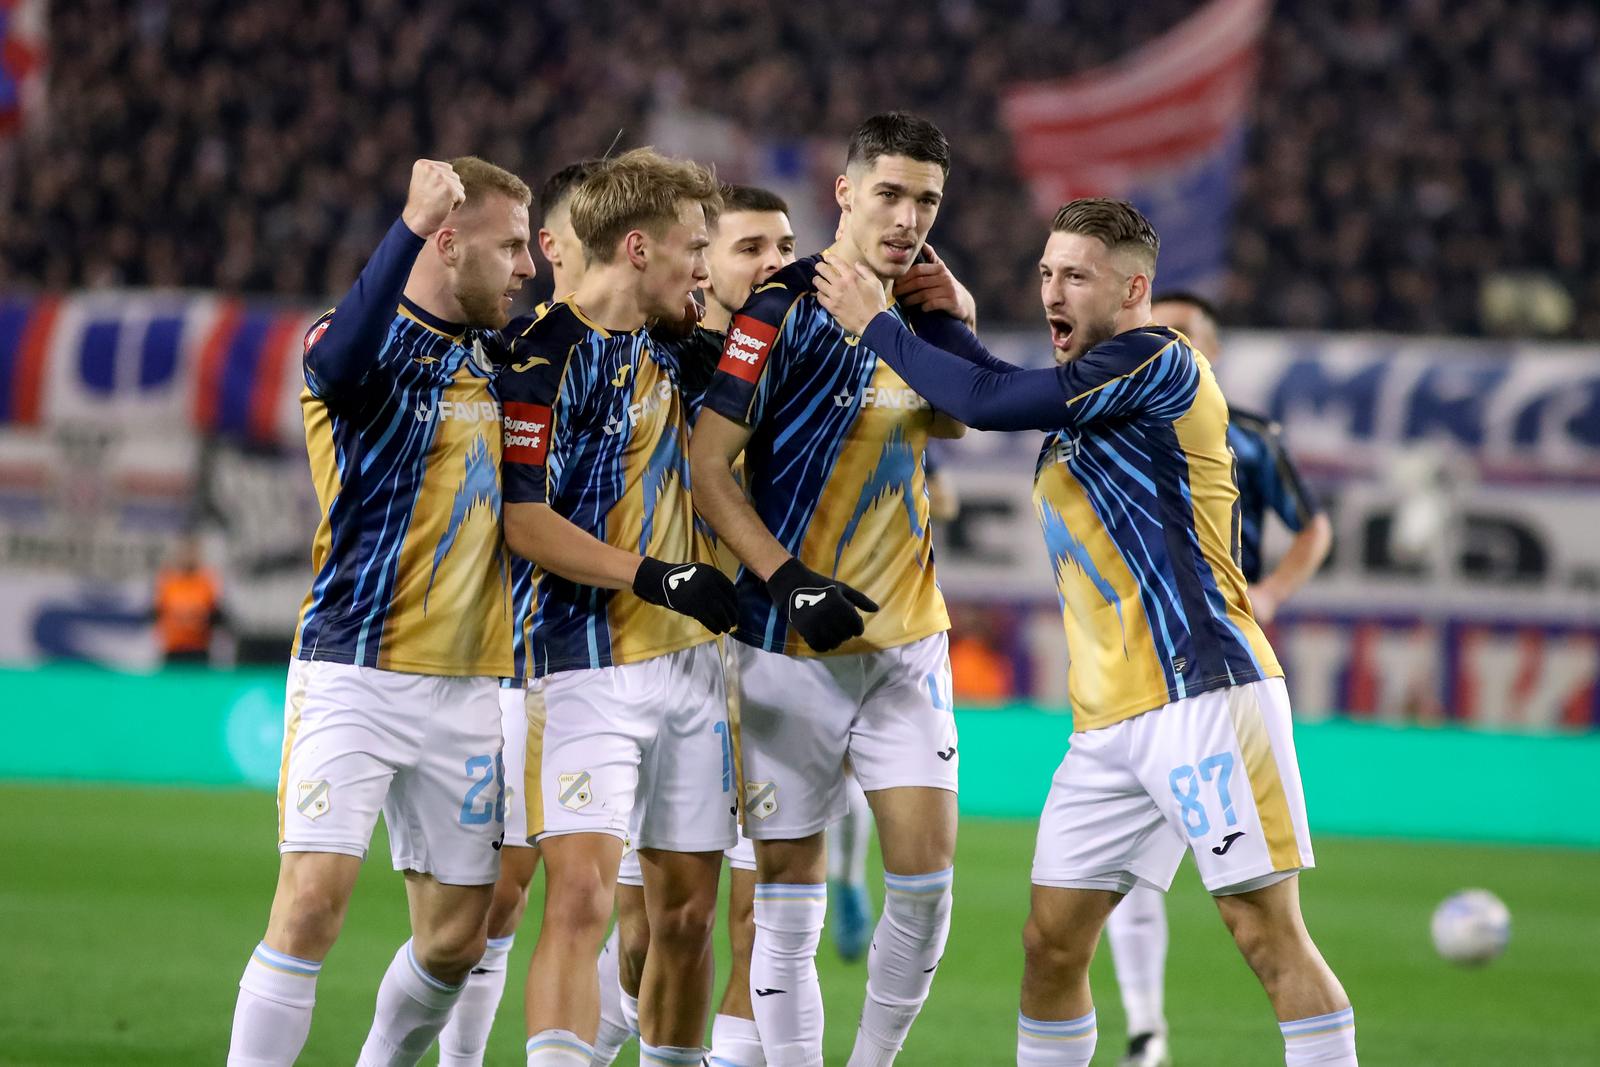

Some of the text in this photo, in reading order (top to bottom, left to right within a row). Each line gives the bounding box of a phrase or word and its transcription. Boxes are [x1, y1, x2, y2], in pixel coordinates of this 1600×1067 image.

[731, 328, 767, 350] Super
[726, 343, 759, 365] Sport
[504, 416, 545, 433] Super
[504, 432, 540, 448] Sport
[1168, 752, 1237, 838] 87
